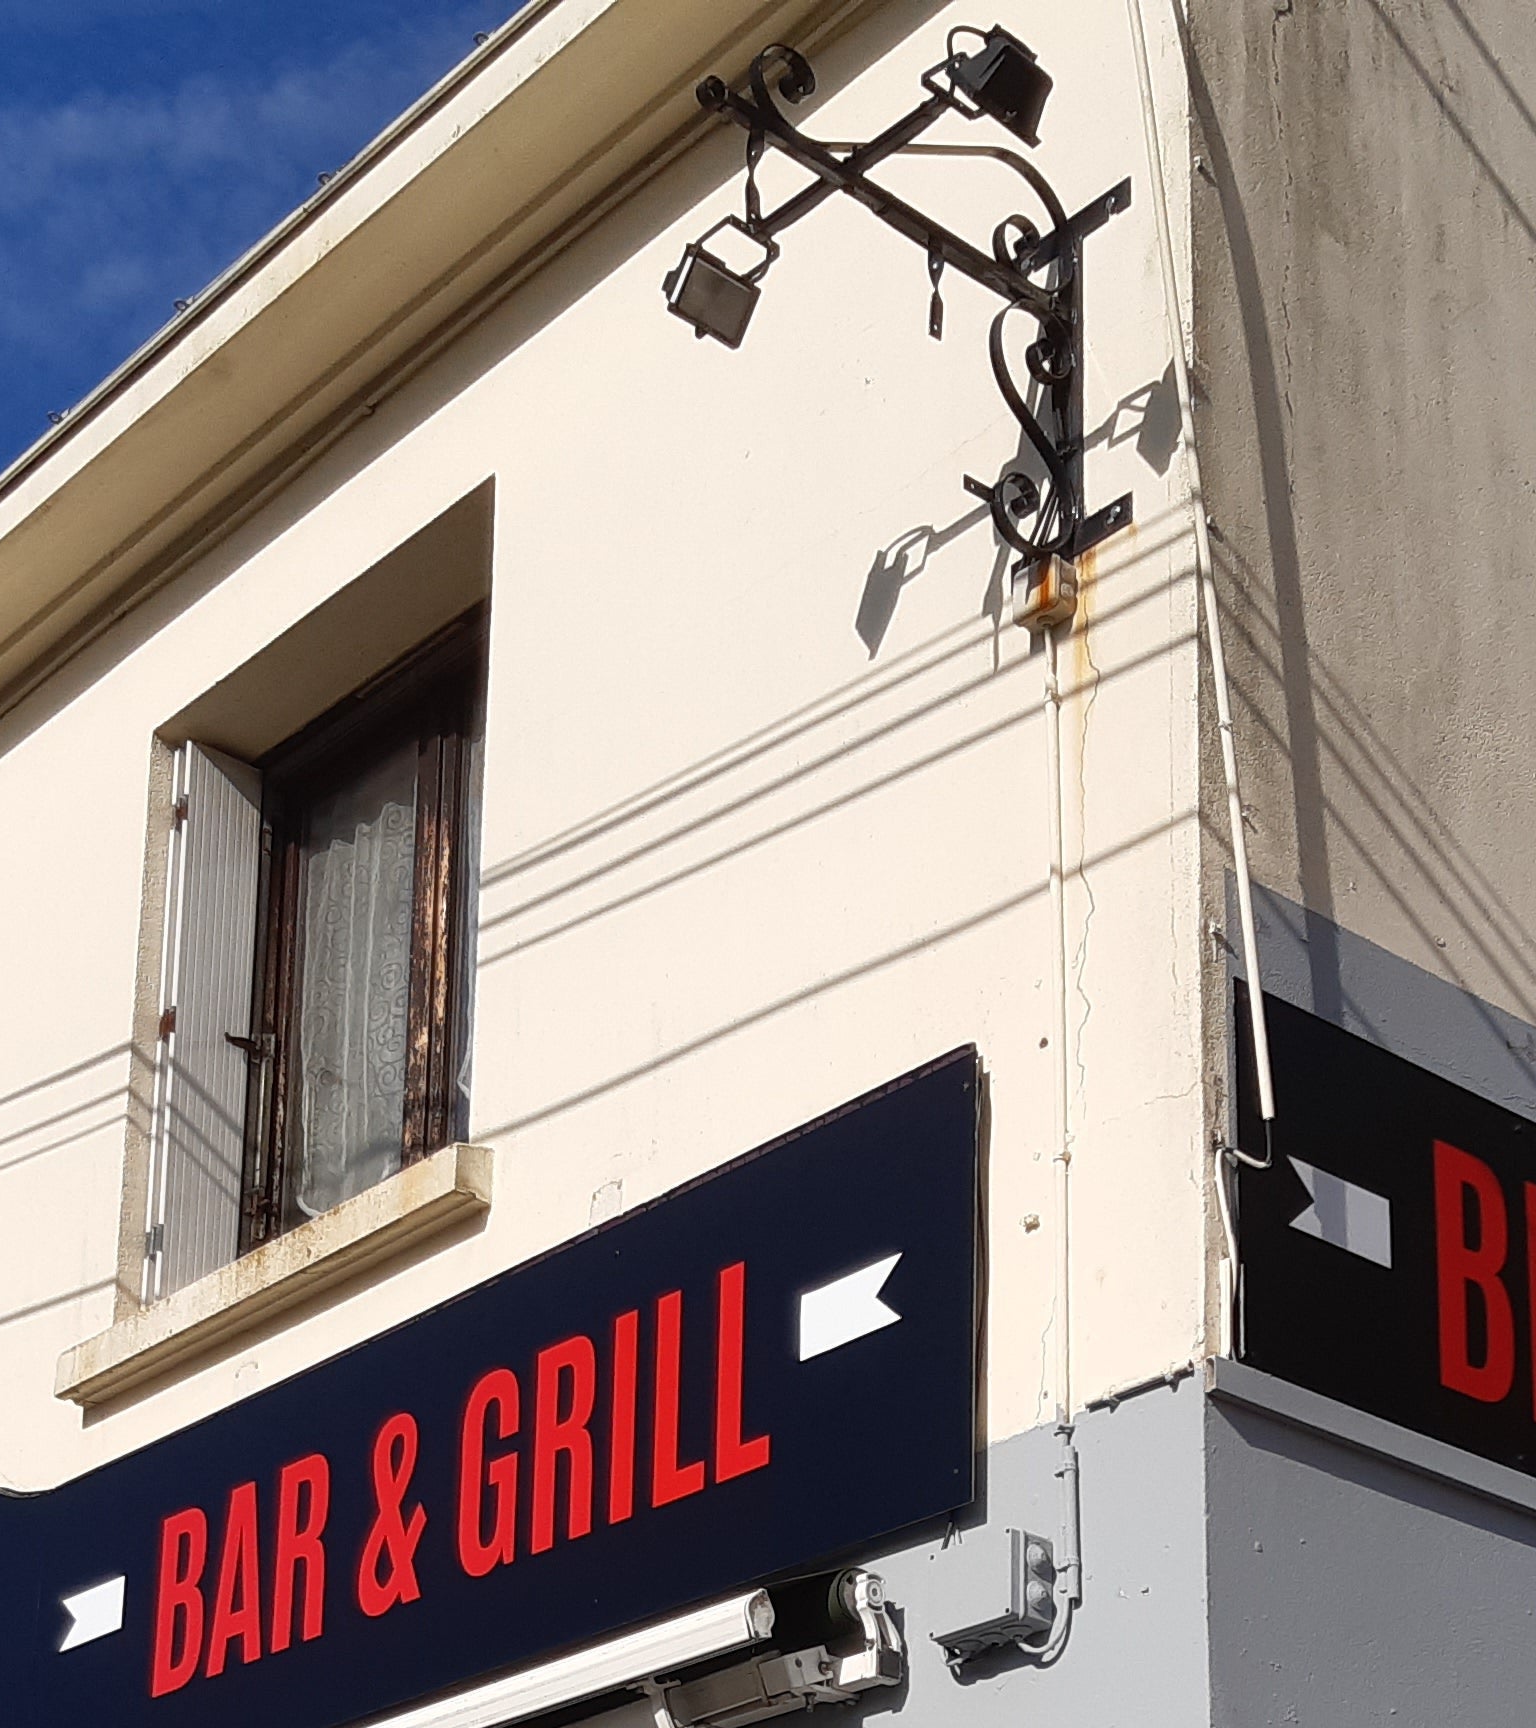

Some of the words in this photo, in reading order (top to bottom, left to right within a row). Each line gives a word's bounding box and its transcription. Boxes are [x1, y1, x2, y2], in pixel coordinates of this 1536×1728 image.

[150, 1452, 330, 1699] BAR
[357, 1412, 428, 1618] &
[455, 1261, 773, 1577] GRILL
